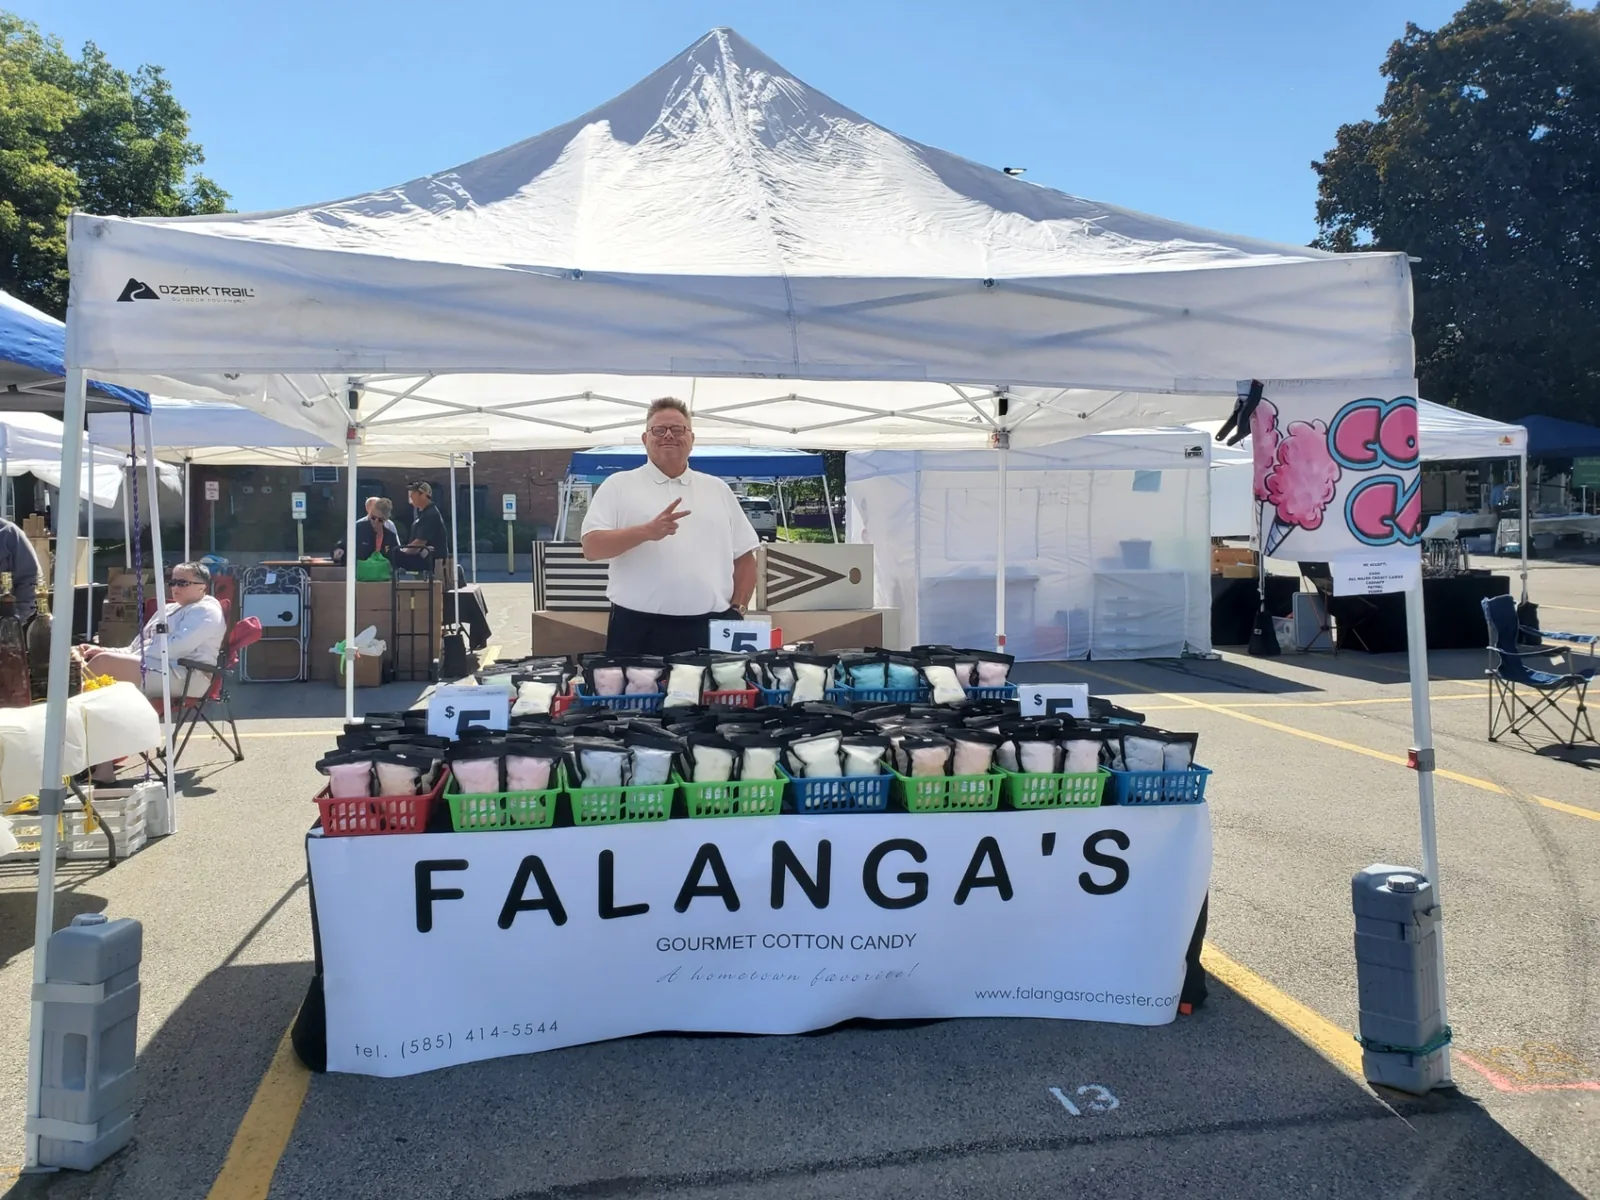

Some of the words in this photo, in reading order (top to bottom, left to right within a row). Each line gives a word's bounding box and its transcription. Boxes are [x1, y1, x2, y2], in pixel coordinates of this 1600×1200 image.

[414, 828, 1131, 934] FALANGA'S
[656, 934, 757, 952] GOURMET
[762, 933, 844, 950] COTTON
[850, 932, 917, 950] CANDY
[656, 965, 682, 983] A
[690, 965, 800, 981] hometown
[355, 1043, 388, 1058] tel.
[401, 1032, 453, 1059] (585)
[465, 1020, 558, 1042] 414-5544
[1049, 1085, 1120, 1115] 13
